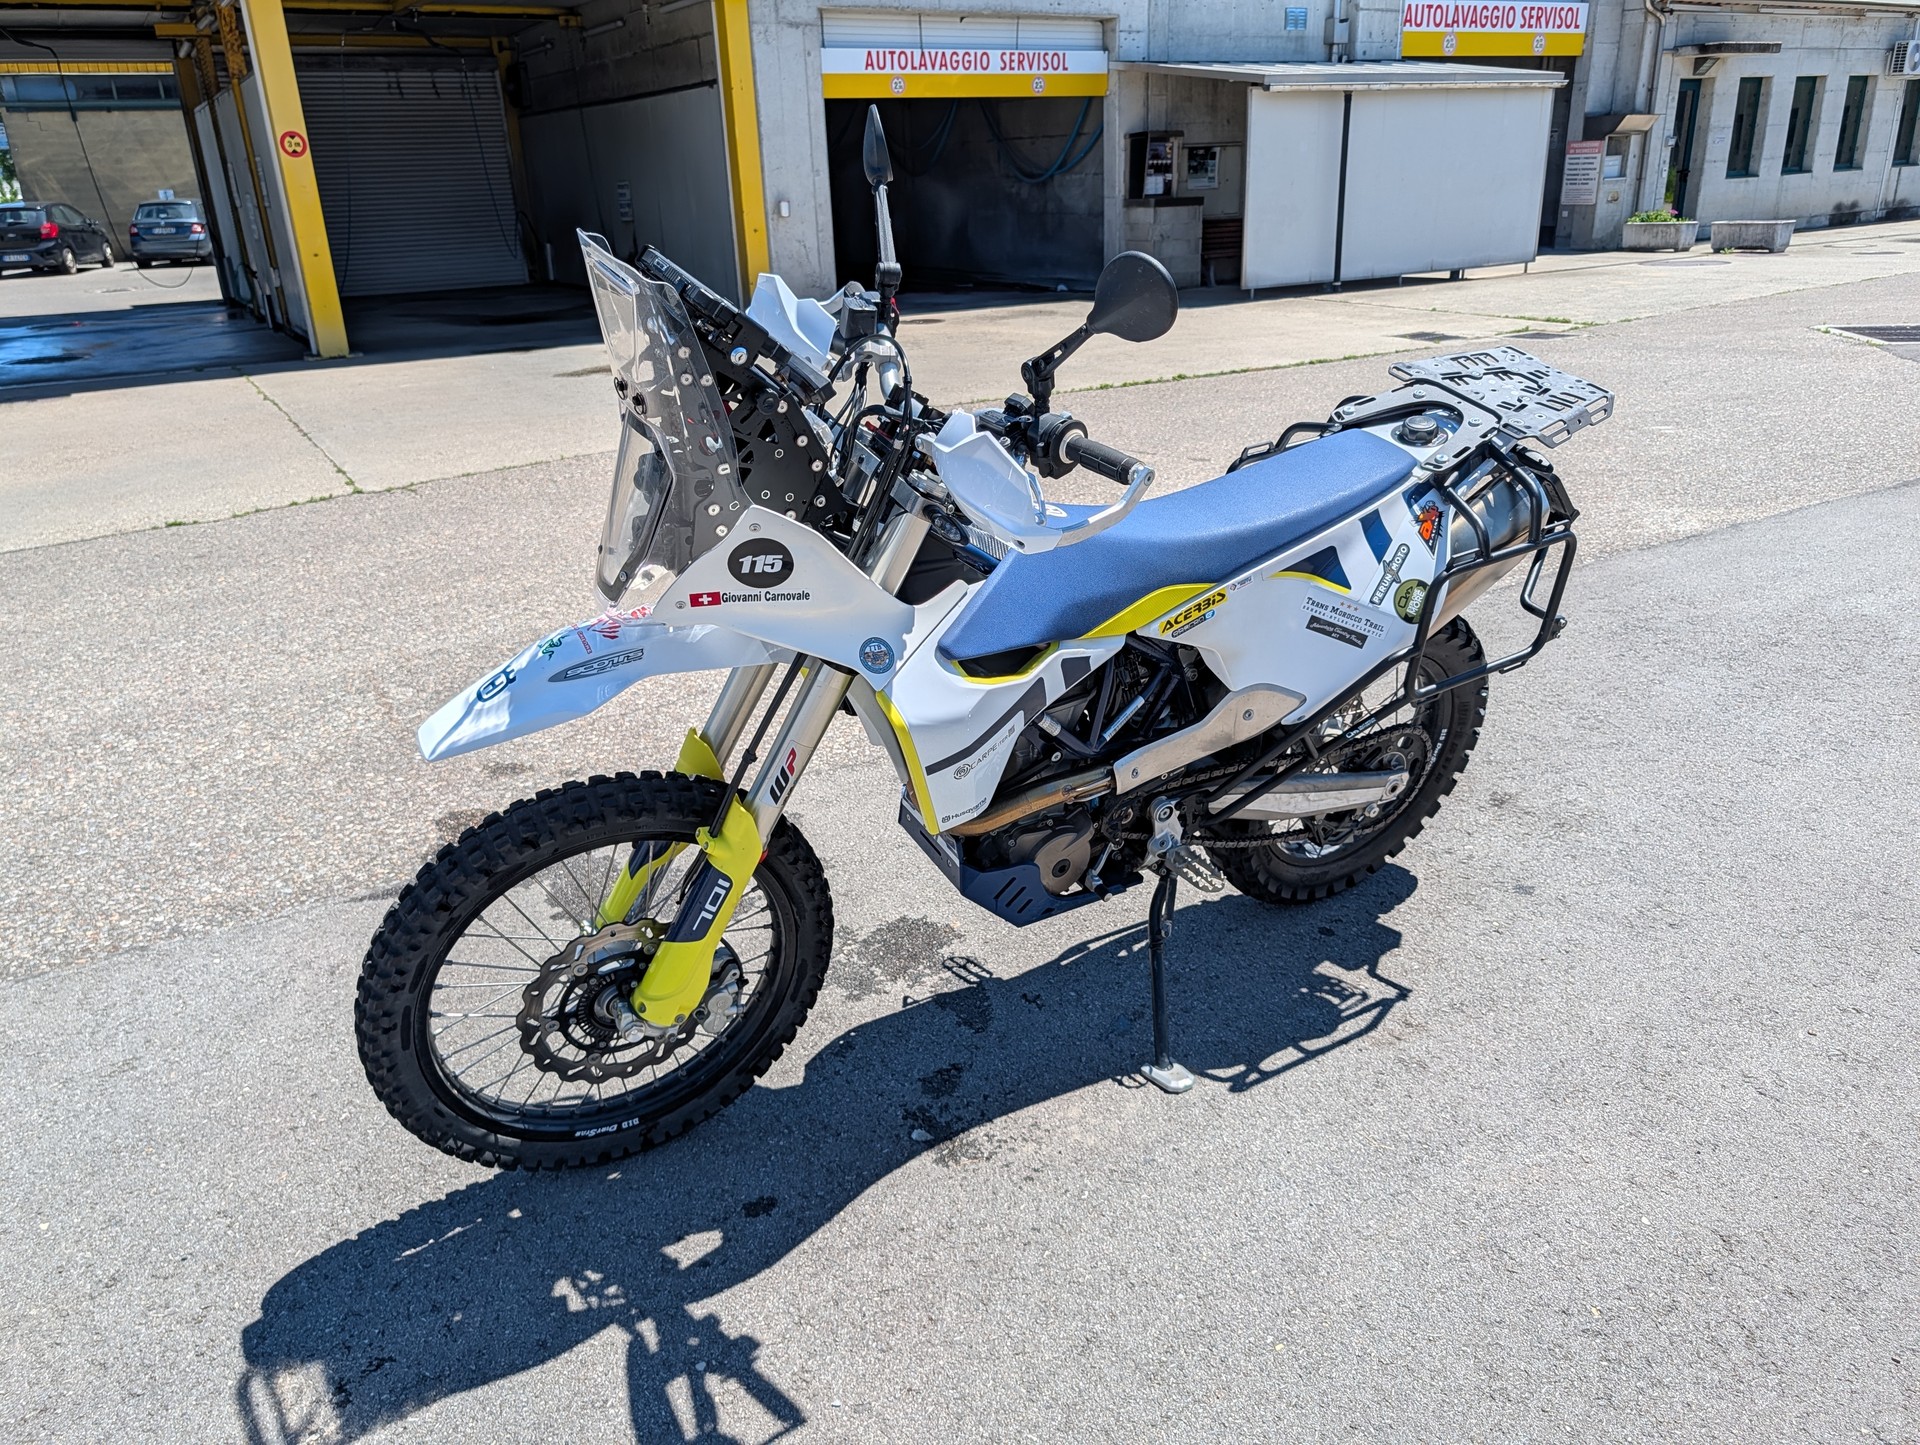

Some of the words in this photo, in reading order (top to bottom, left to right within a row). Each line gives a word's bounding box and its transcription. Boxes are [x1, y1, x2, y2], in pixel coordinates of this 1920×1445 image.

[1403, 4, 1516, 29] AUTOLAVAGGIO
[1519, 6, 1580, 29] SERVISOL
[864, 50, 990, 71] AUTOLAVAGGIO
[1000, 51, 1069, 71] SERVISOL
[738, 554, 784, 574] 115
[1371, 573, 1393, 605] PERUN
[1391, 545, 1408, 572] MOTO
[721, 591, 762, 603] Giovanni
[764, 590, 811, 602] Carnovale
[1410, 590, 1425, 616] MORE
[1161, 592, 1227, 634] ACERBIS
[564, 648, 644, 679] SCOTTS
[970, 743, 998, 770] CARPE
[769, 747, 797, 806] WP
[951, 797, 987, 820] Husqvarna
[692, 878, 731, 931] 701
[621, 1117, 640, 1129] DID
